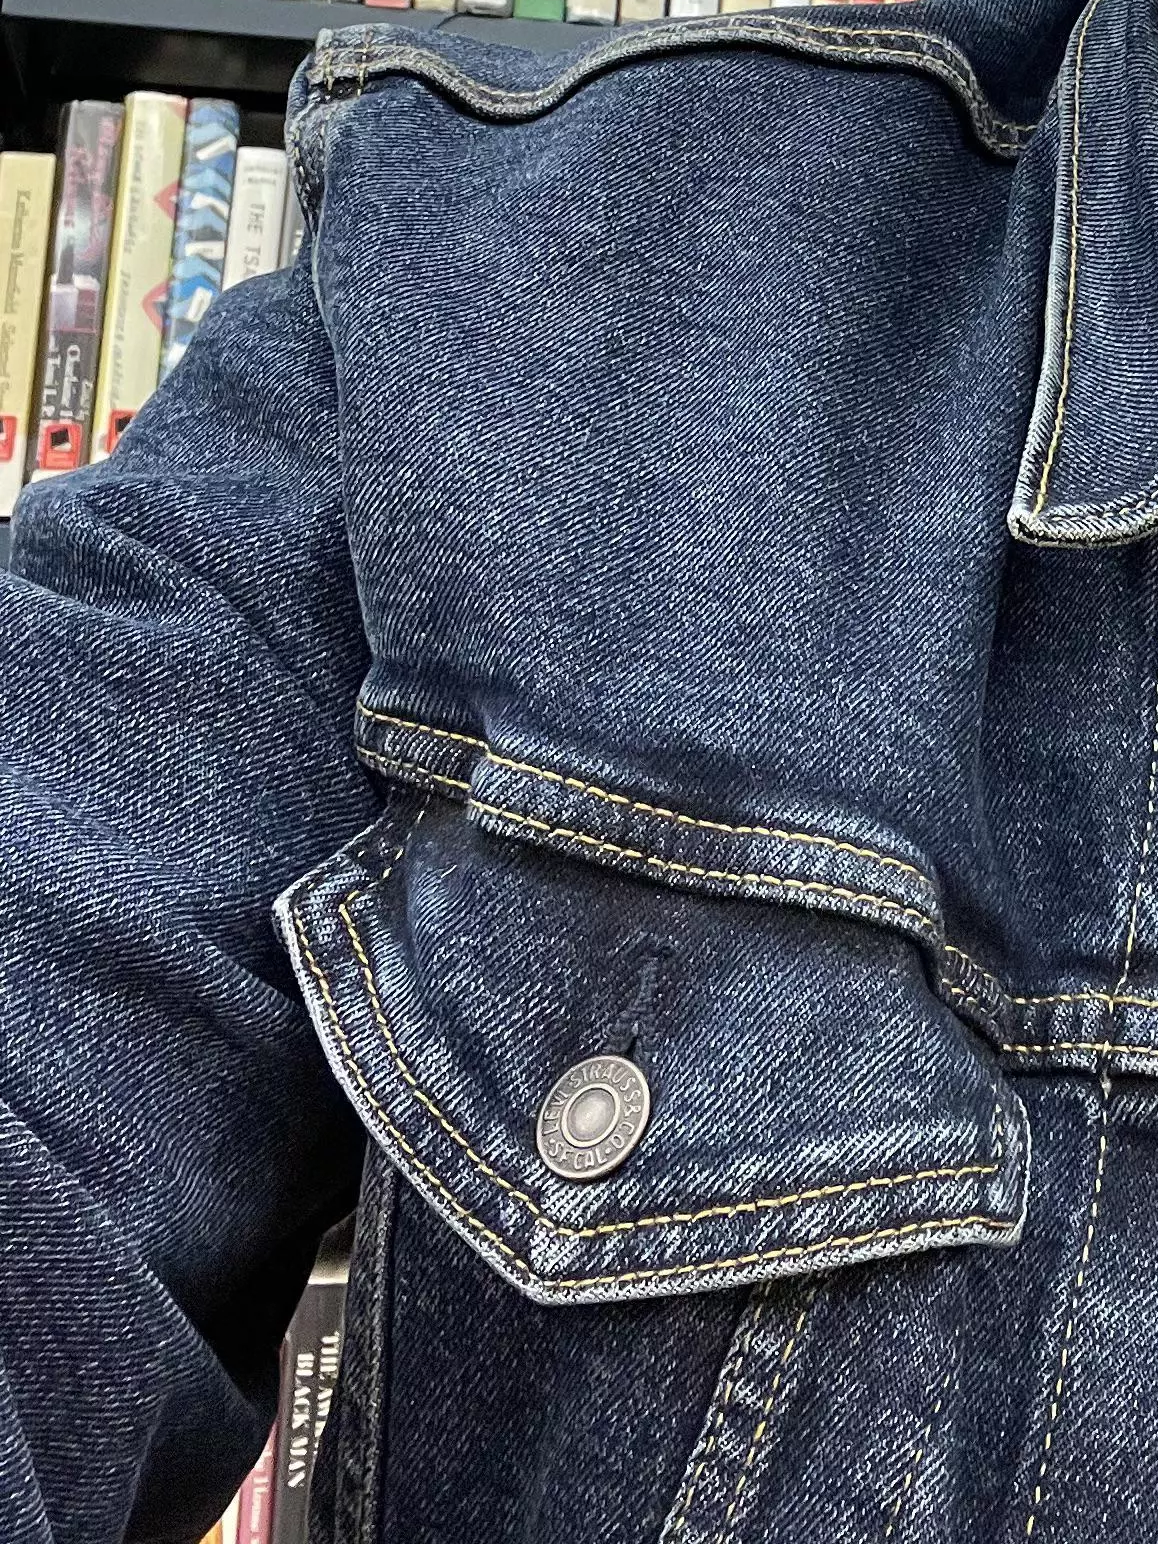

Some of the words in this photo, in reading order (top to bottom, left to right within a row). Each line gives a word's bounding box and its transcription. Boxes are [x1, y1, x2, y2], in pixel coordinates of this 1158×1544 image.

[247, 202, 267, 235] THE
[568, 1064, 642, 1103] STRAUSS
[319, 1330, 340, 1380] THE
[291, 1352, 314, 1431] BLACK
[287, 1435, 309, 1488] MAN
